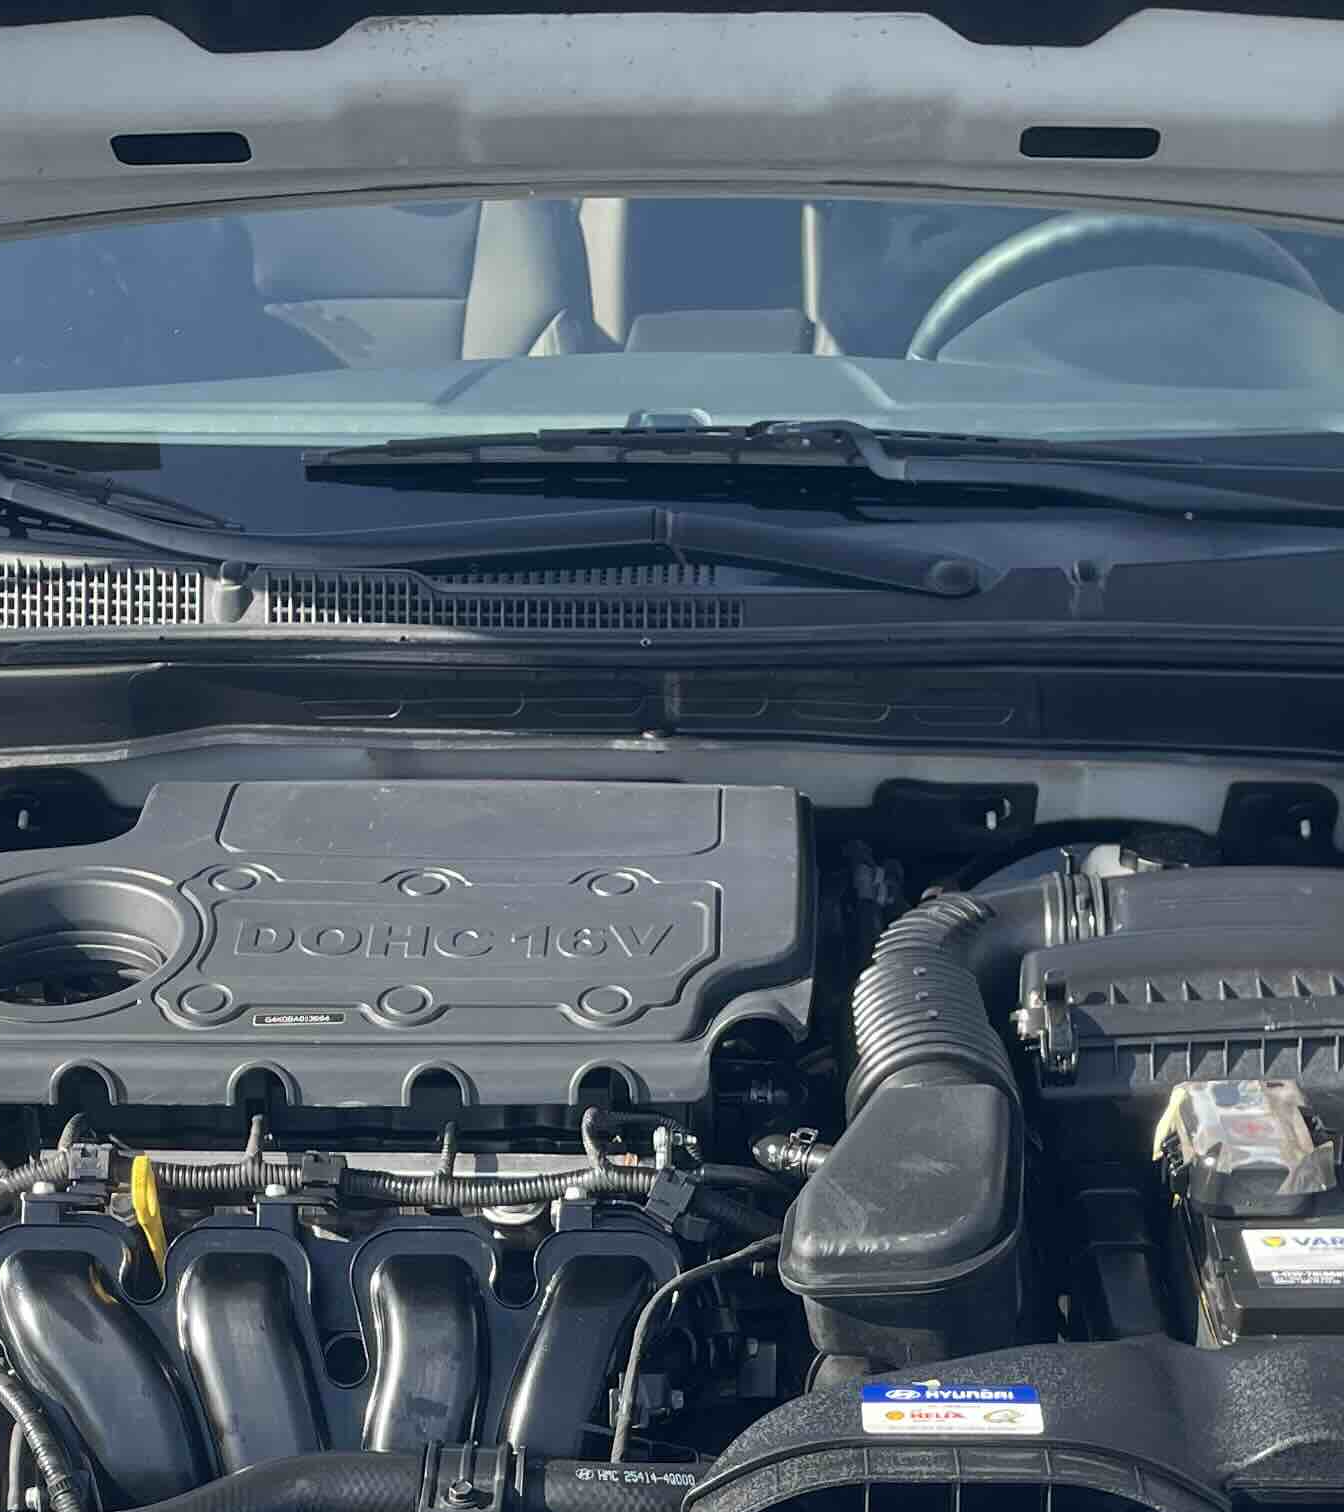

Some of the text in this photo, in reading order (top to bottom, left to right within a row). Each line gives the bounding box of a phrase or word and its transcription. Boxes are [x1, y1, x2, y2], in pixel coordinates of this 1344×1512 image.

[233, 920, 675, 959] DOHC 16V
[924, 1388, 1014, 1400] HYUNDAI
[596, 1469, 619, 1481] HMC
